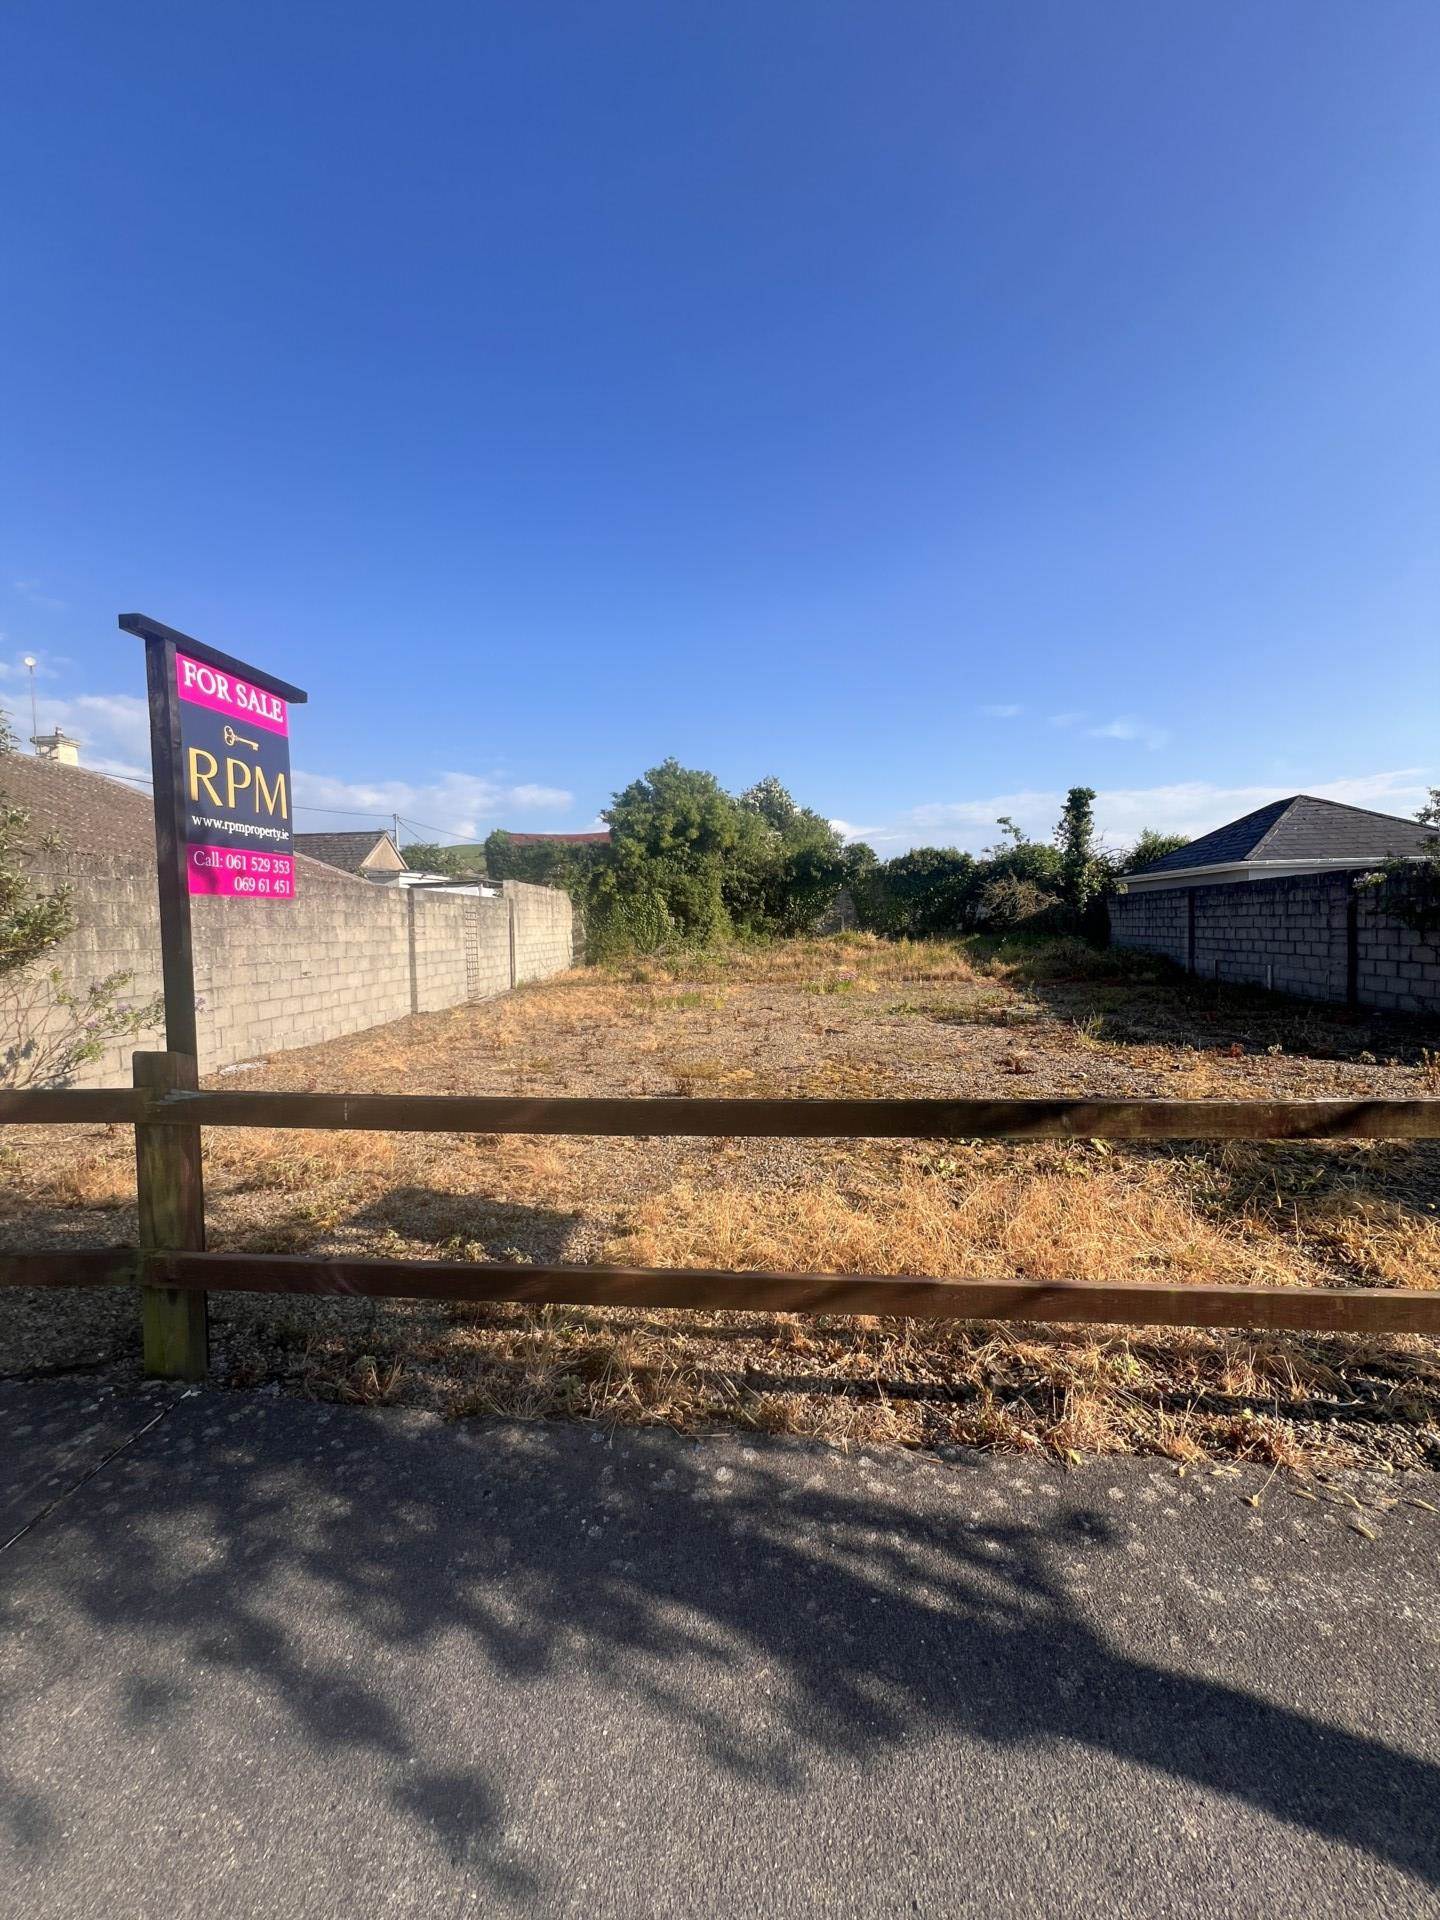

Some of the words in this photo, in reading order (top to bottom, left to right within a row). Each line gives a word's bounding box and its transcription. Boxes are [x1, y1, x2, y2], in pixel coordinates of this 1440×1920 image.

[182, 660, 232, 704] FOR
[235, 683, 284, 722] SALE
[188, 747, 288, 819] RPM
[191, 815, 290, 841] www.rpmproperty.ie
[193, 850, 223, 868] Call:
[226, 854, 247, 871] 061
[251, 857, 271, 873] 529
[272, 859, 291, 875] 353
[234, 876, 256, 892] 069
[258, 878, 270, 893] 61
[274, 880, 290, 894] 451
